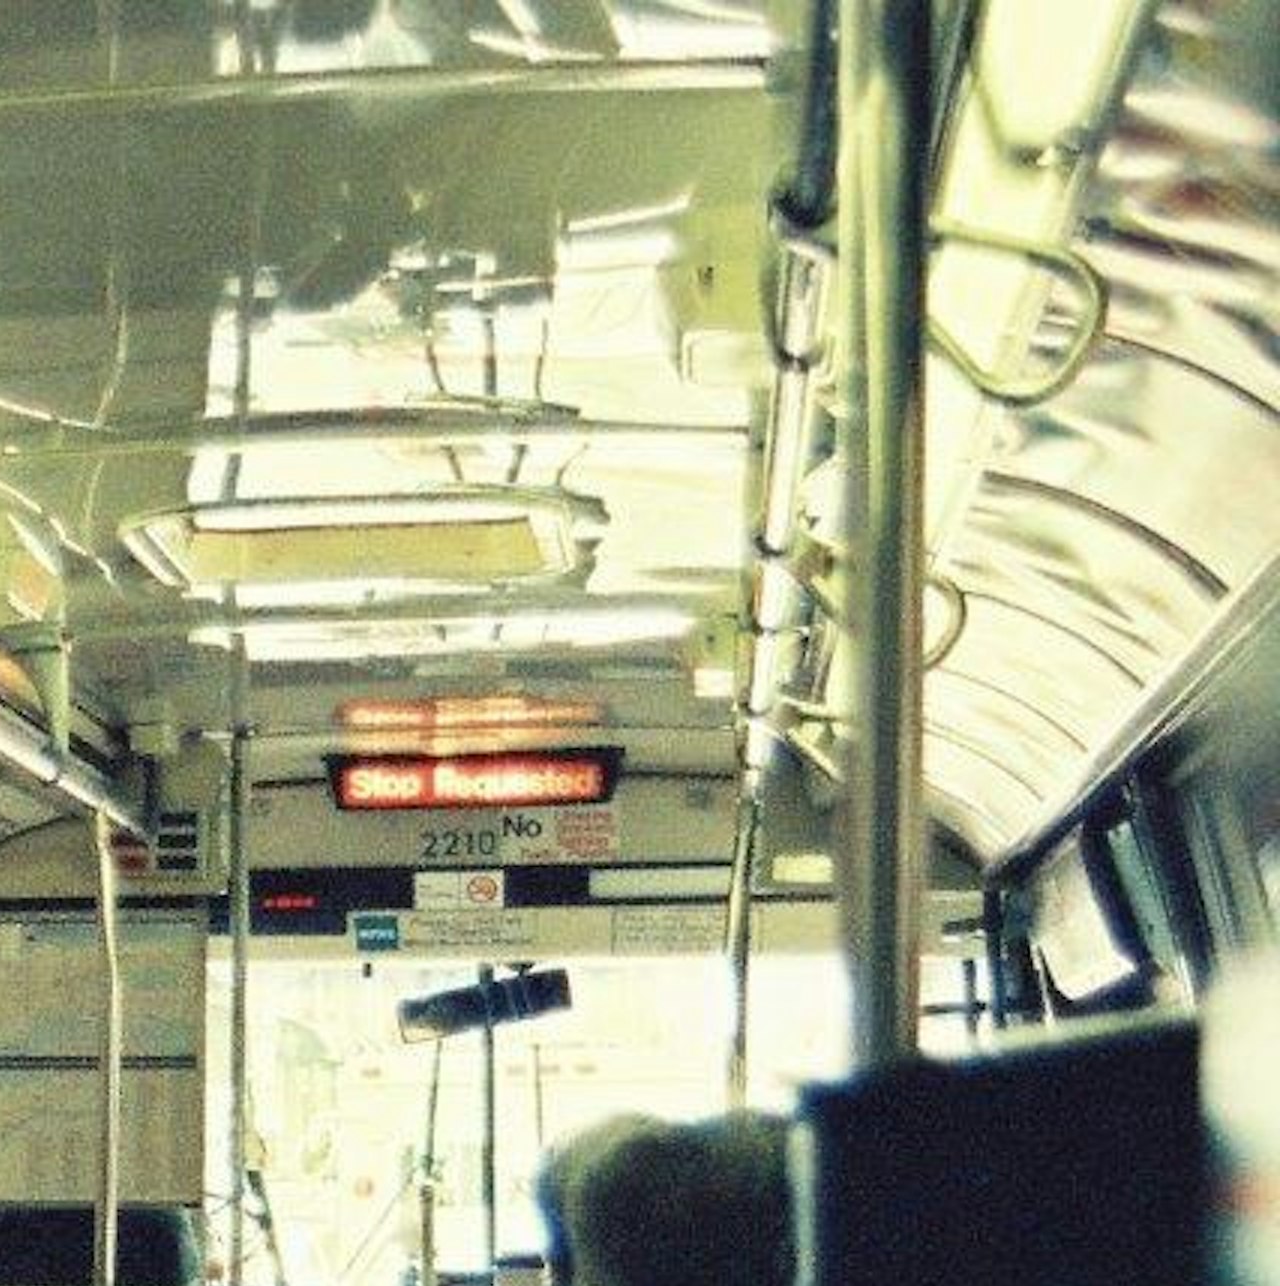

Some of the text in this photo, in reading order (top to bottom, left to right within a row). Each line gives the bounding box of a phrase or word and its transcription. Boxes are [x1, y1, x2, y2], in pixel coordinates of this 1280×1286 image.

[348, 761, 602, 799] Stop Requested
[501, 814, 543, 838] No
[419, 830, 495, 858] 2210
